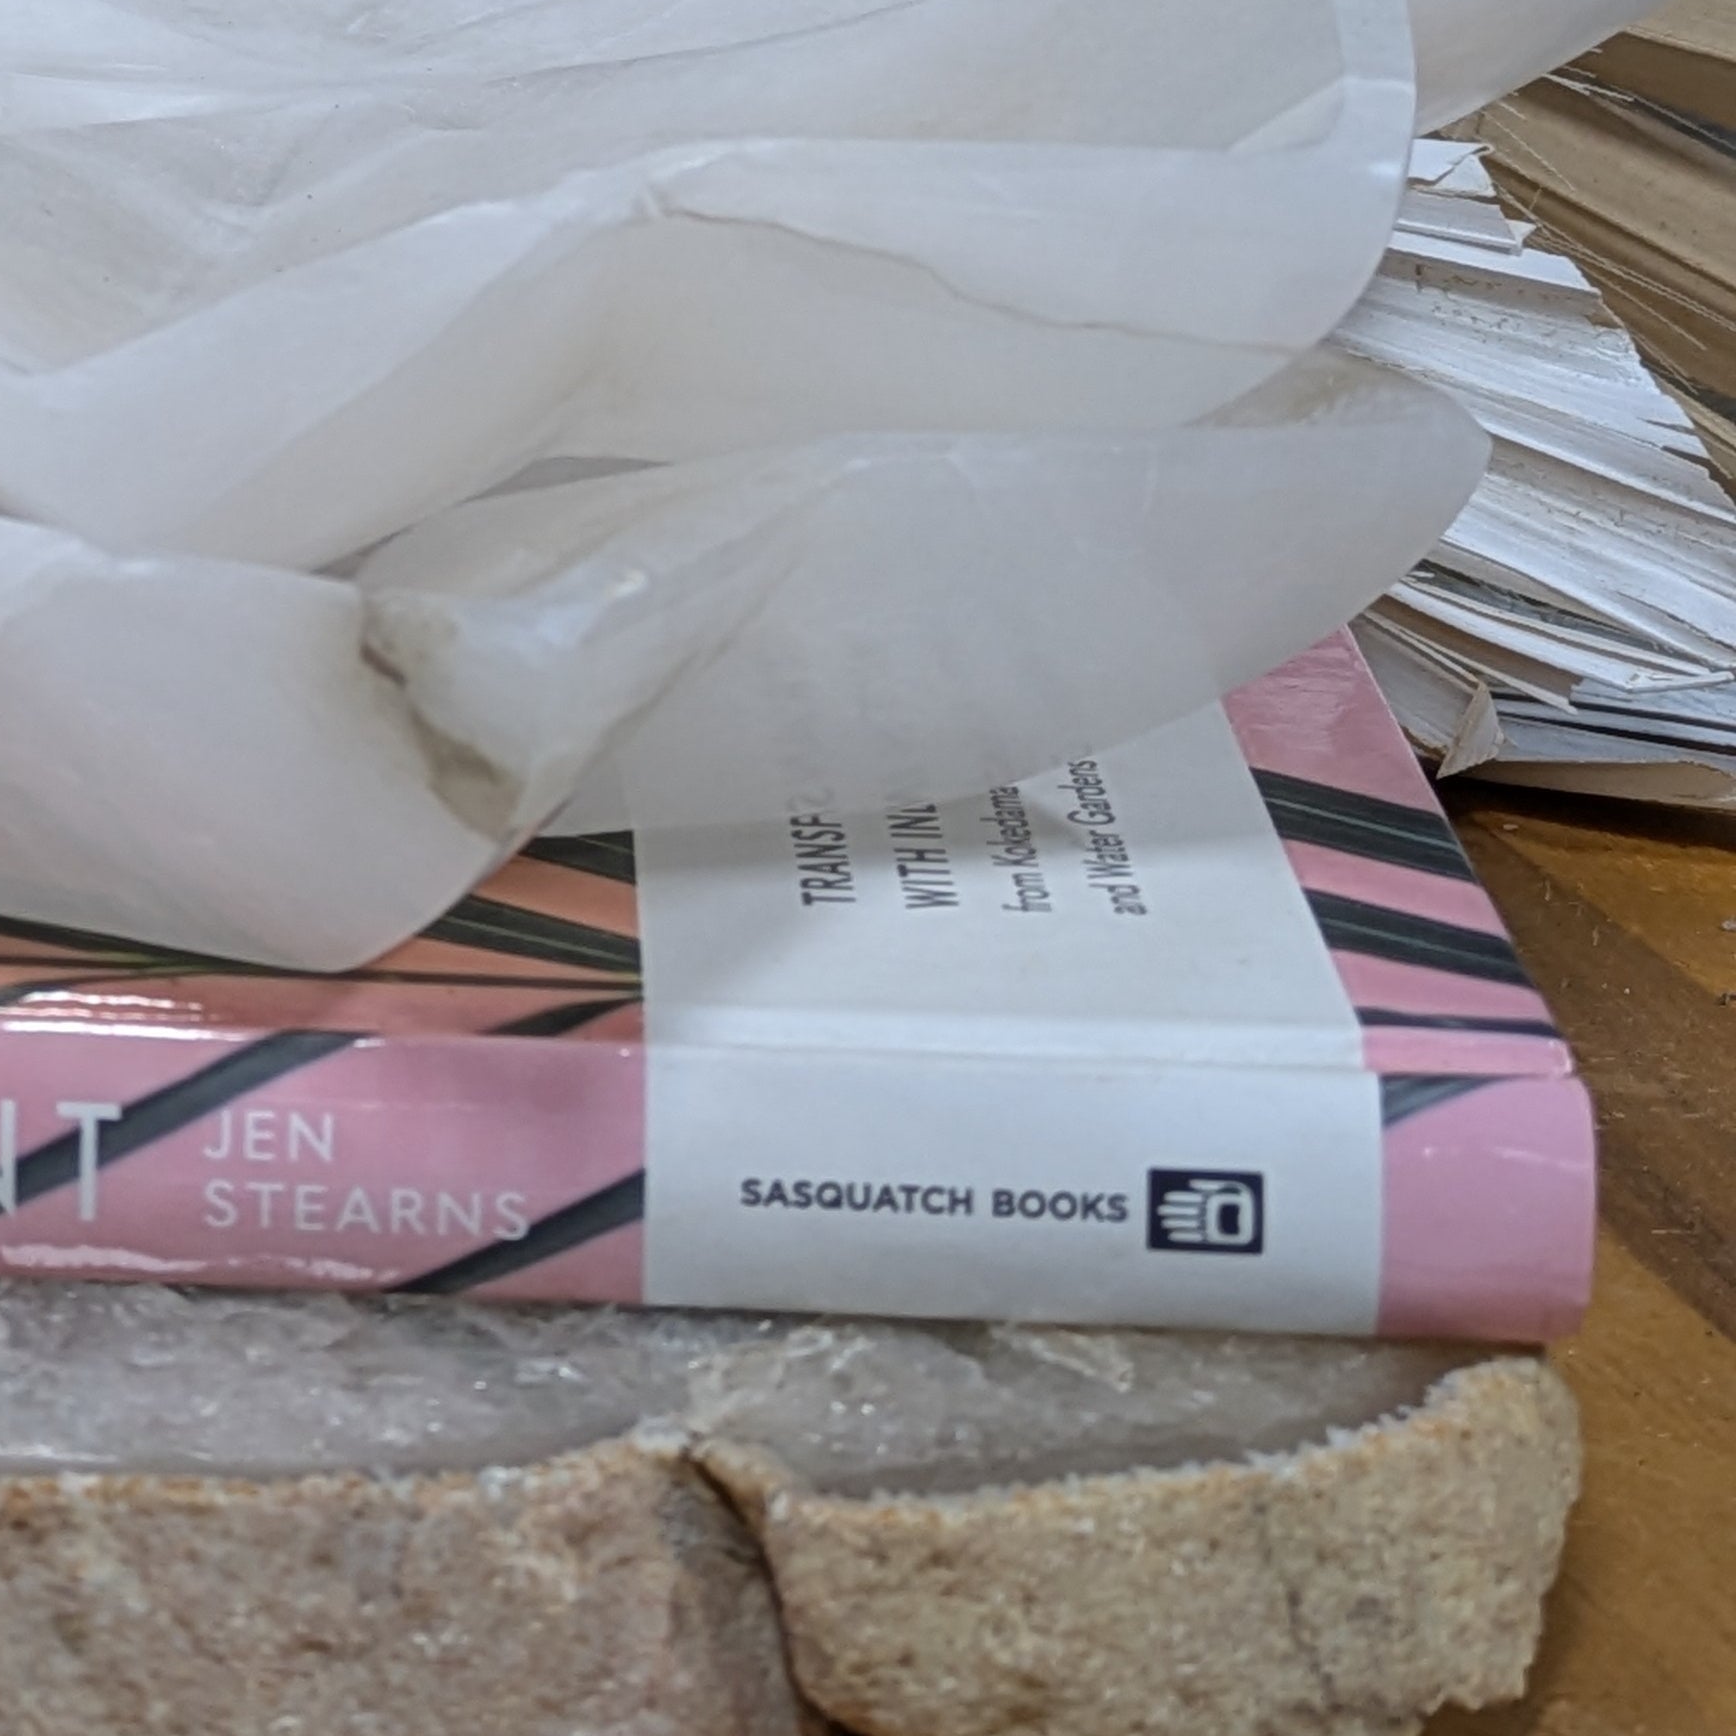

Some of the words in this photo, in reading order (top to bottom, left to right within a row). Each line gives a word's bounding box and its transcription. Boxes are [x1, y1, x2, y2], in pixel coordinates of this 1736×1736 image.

[1057, 759, 1116, 826] Gardens
[980, 785, 1040, 867] Kokedama
[1082, 829, 1134, 879] Water
[789, 812, 856, 905] TRANSF
[894, 847, 959, 909] WITH
[1002, 871, 1053, 913] from
[1088, 882, 1148, 915] and
[202, 1110, 335, 1163] JEN
[202, 1179, 531, 1242] STEARNS
[739, 1177, 974, 1217] SASQUATCH
[991, 1188, 1129, 1224] BOOKS
